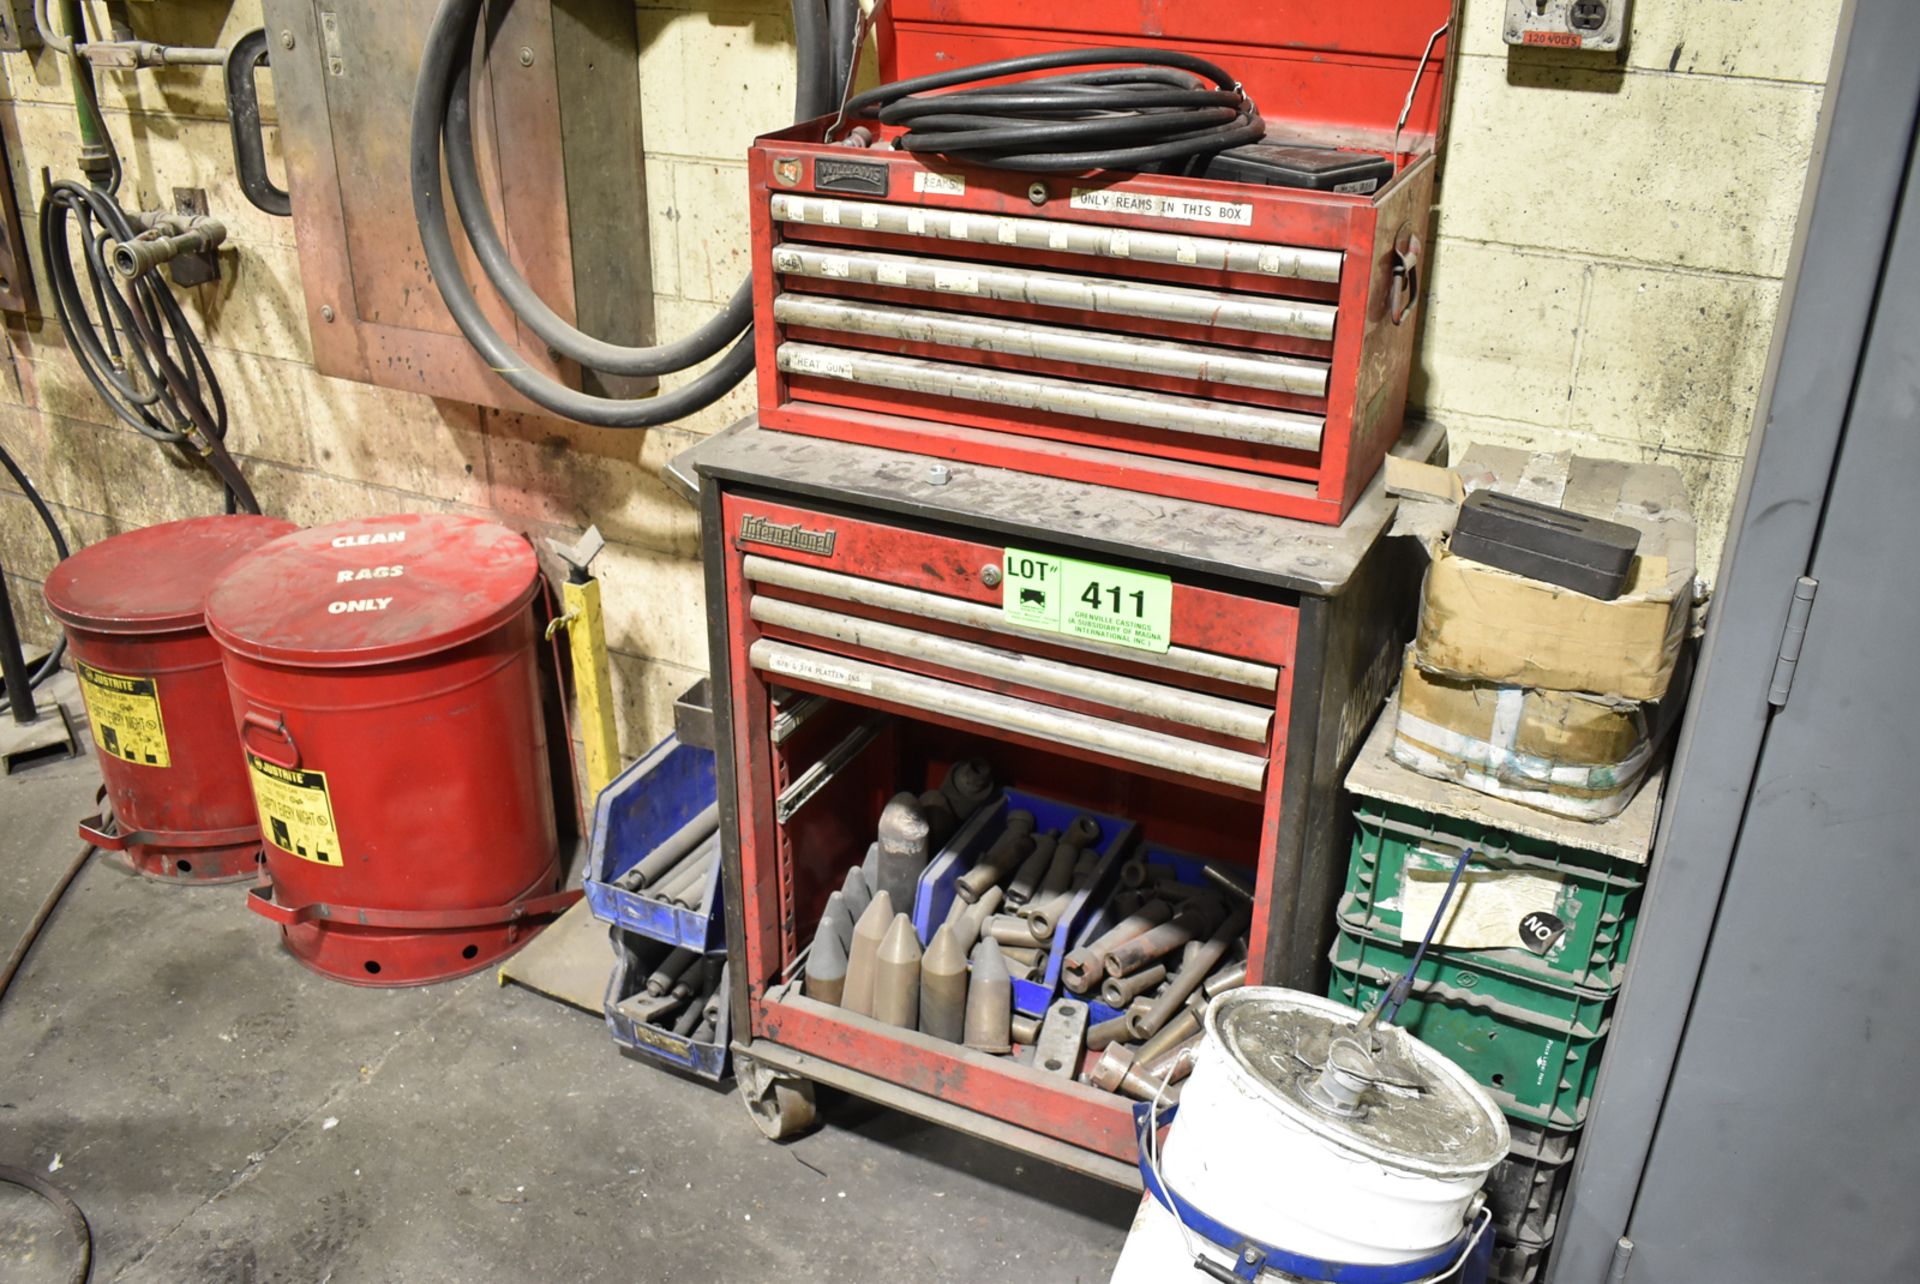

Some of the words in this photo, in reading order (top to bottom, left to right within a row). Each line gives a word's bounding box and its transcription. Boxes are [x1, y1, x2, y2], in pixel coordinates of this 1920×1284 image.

[1528, 33, 1546, 43] 120
[1547, 35, 1577, 46] VOLTS
[819, 161, 882, 183] WILLIAMS
[1080, 193, 1110, 206] ONLY
[1116, 197, 1153, 211] REAMS
[1161, 201, 1174, 213] IN
[1183, 203, 1212, 217] THIS
[1219, 207, 1242, 220] BOX
[797, 358, 821, 370] HEAT
[826, 363, 844, 374] GUN
[331, 530, 406, 549] CLEAN
[740, 514, 836, 554] International
[336, 564, 404, 584] RAGS
[327, 596, 393, 615] ONLY
[1080, 581, 1144, 618] 411
[1074, 610, 1113, 624] GRENVILLE
[1115, 619, 1152, 631] CASTINGS
[1078, 619, 1121, 632] SUBSIDIARY
[1134, 630, 1162, 641] MAGNA
[1074, 625, 1131, 642] INTERNATIONAL
[93, 673, 135, 691] JUSTRITE
[262, 761, 304, 785] JUSTRITE
